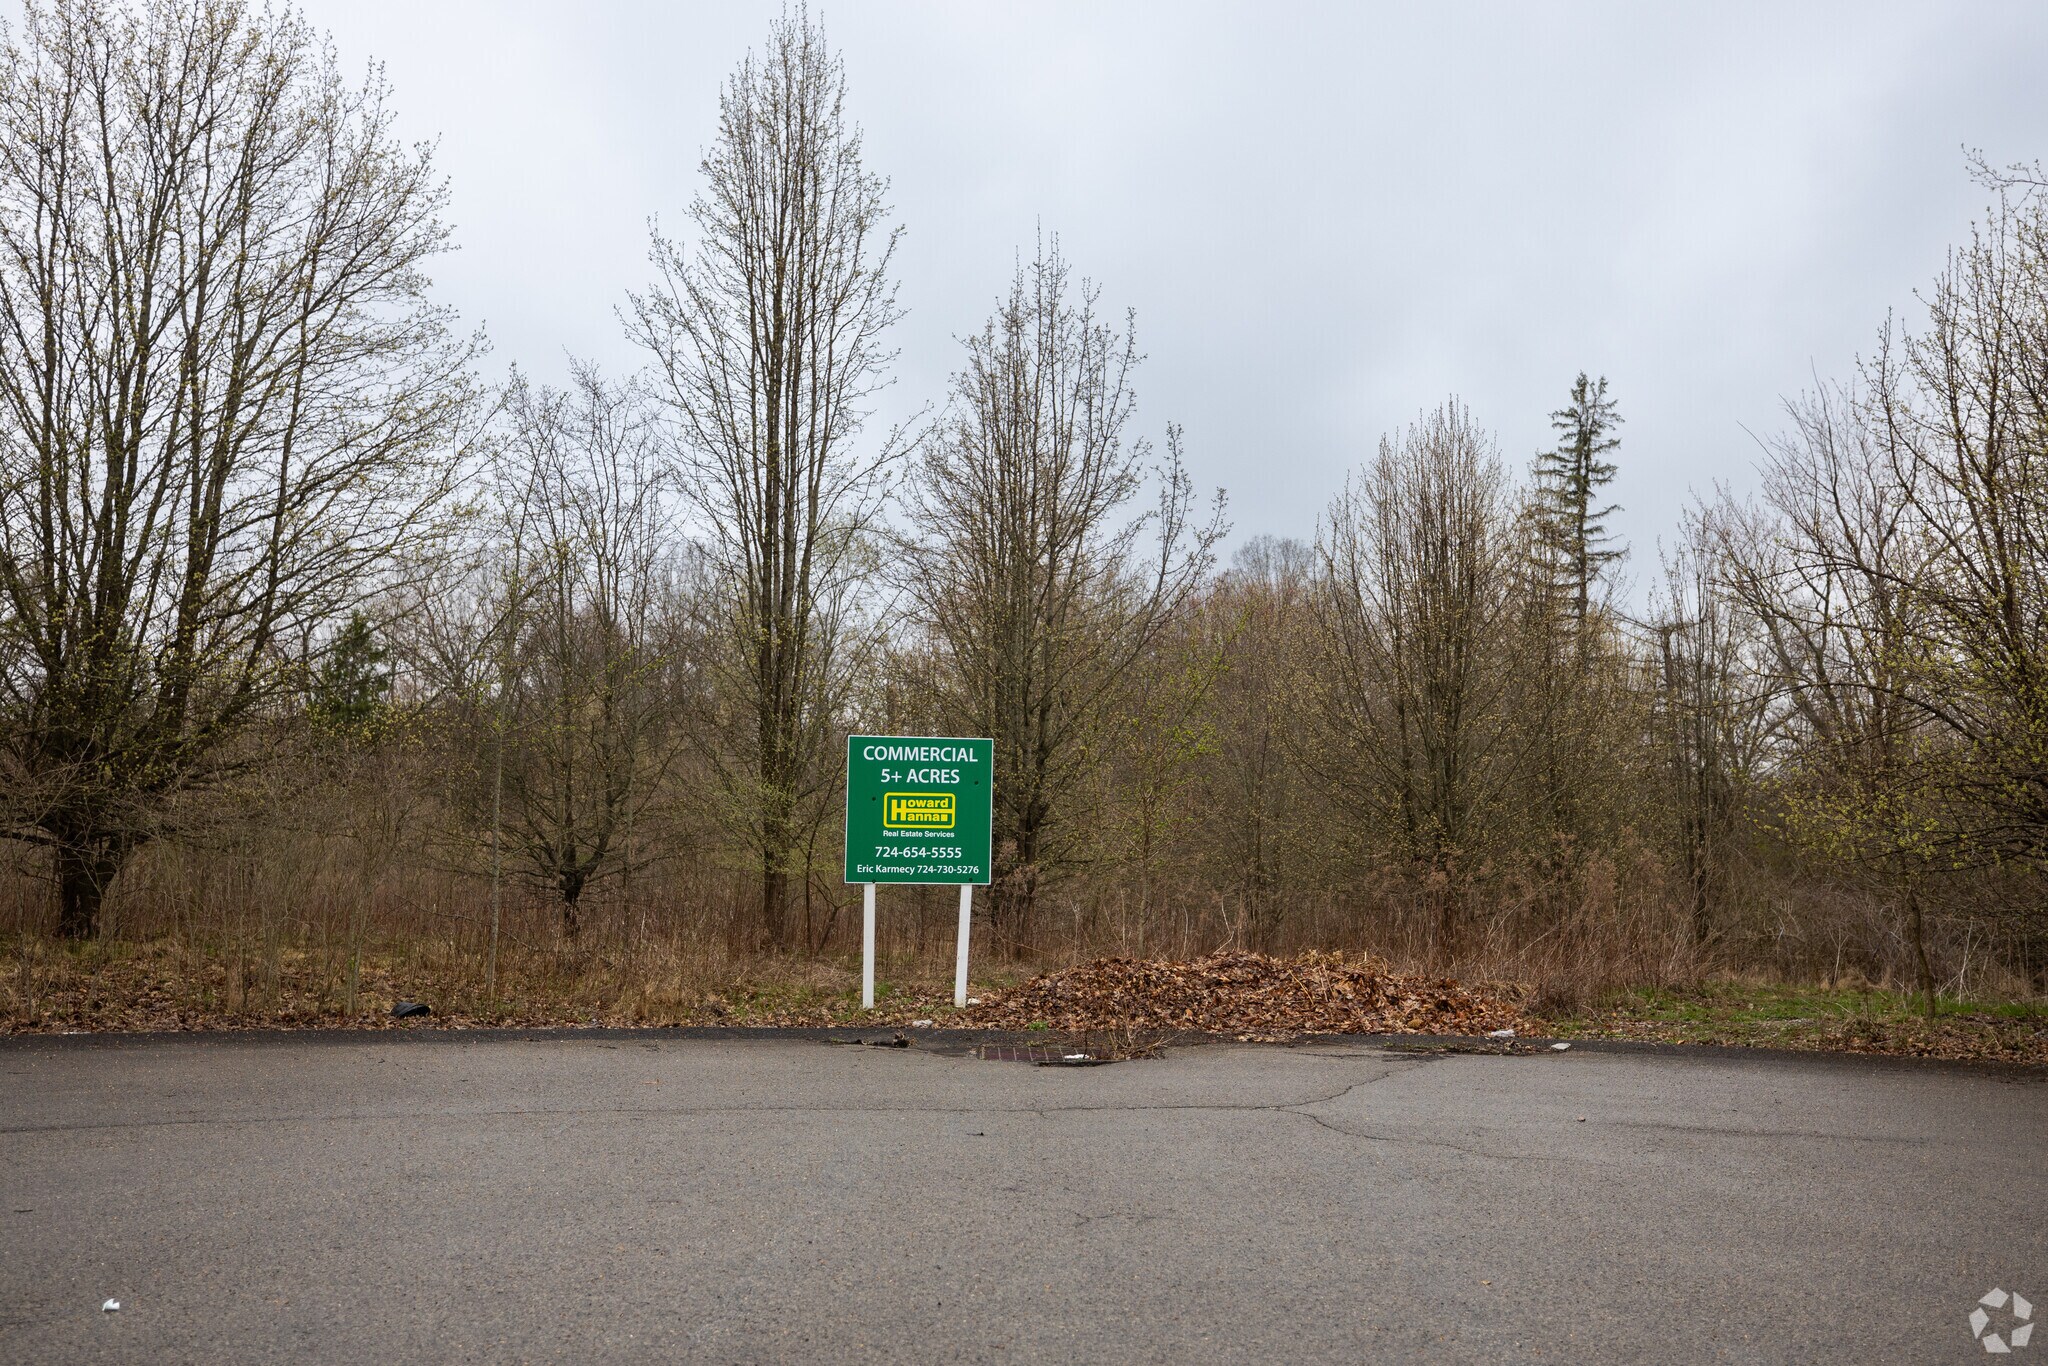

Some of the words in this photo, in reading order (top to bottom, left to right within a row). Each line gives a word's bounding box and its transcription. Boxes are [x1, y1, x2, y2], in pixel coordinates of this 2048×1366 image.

[863, 745, 978, 762] COMMERCIAL
[880, 769, 902, 783] 5+
[906, 769, 960, 784] ACRES
[891, 798, 949, 811] Howard
[875, 846, 962, 858] 724-654-5555
[857, 864, 874, 873] Eric
[875, 864, 915, 876] Karmecy
[917, 865, 979, 874] 724-730-5276
